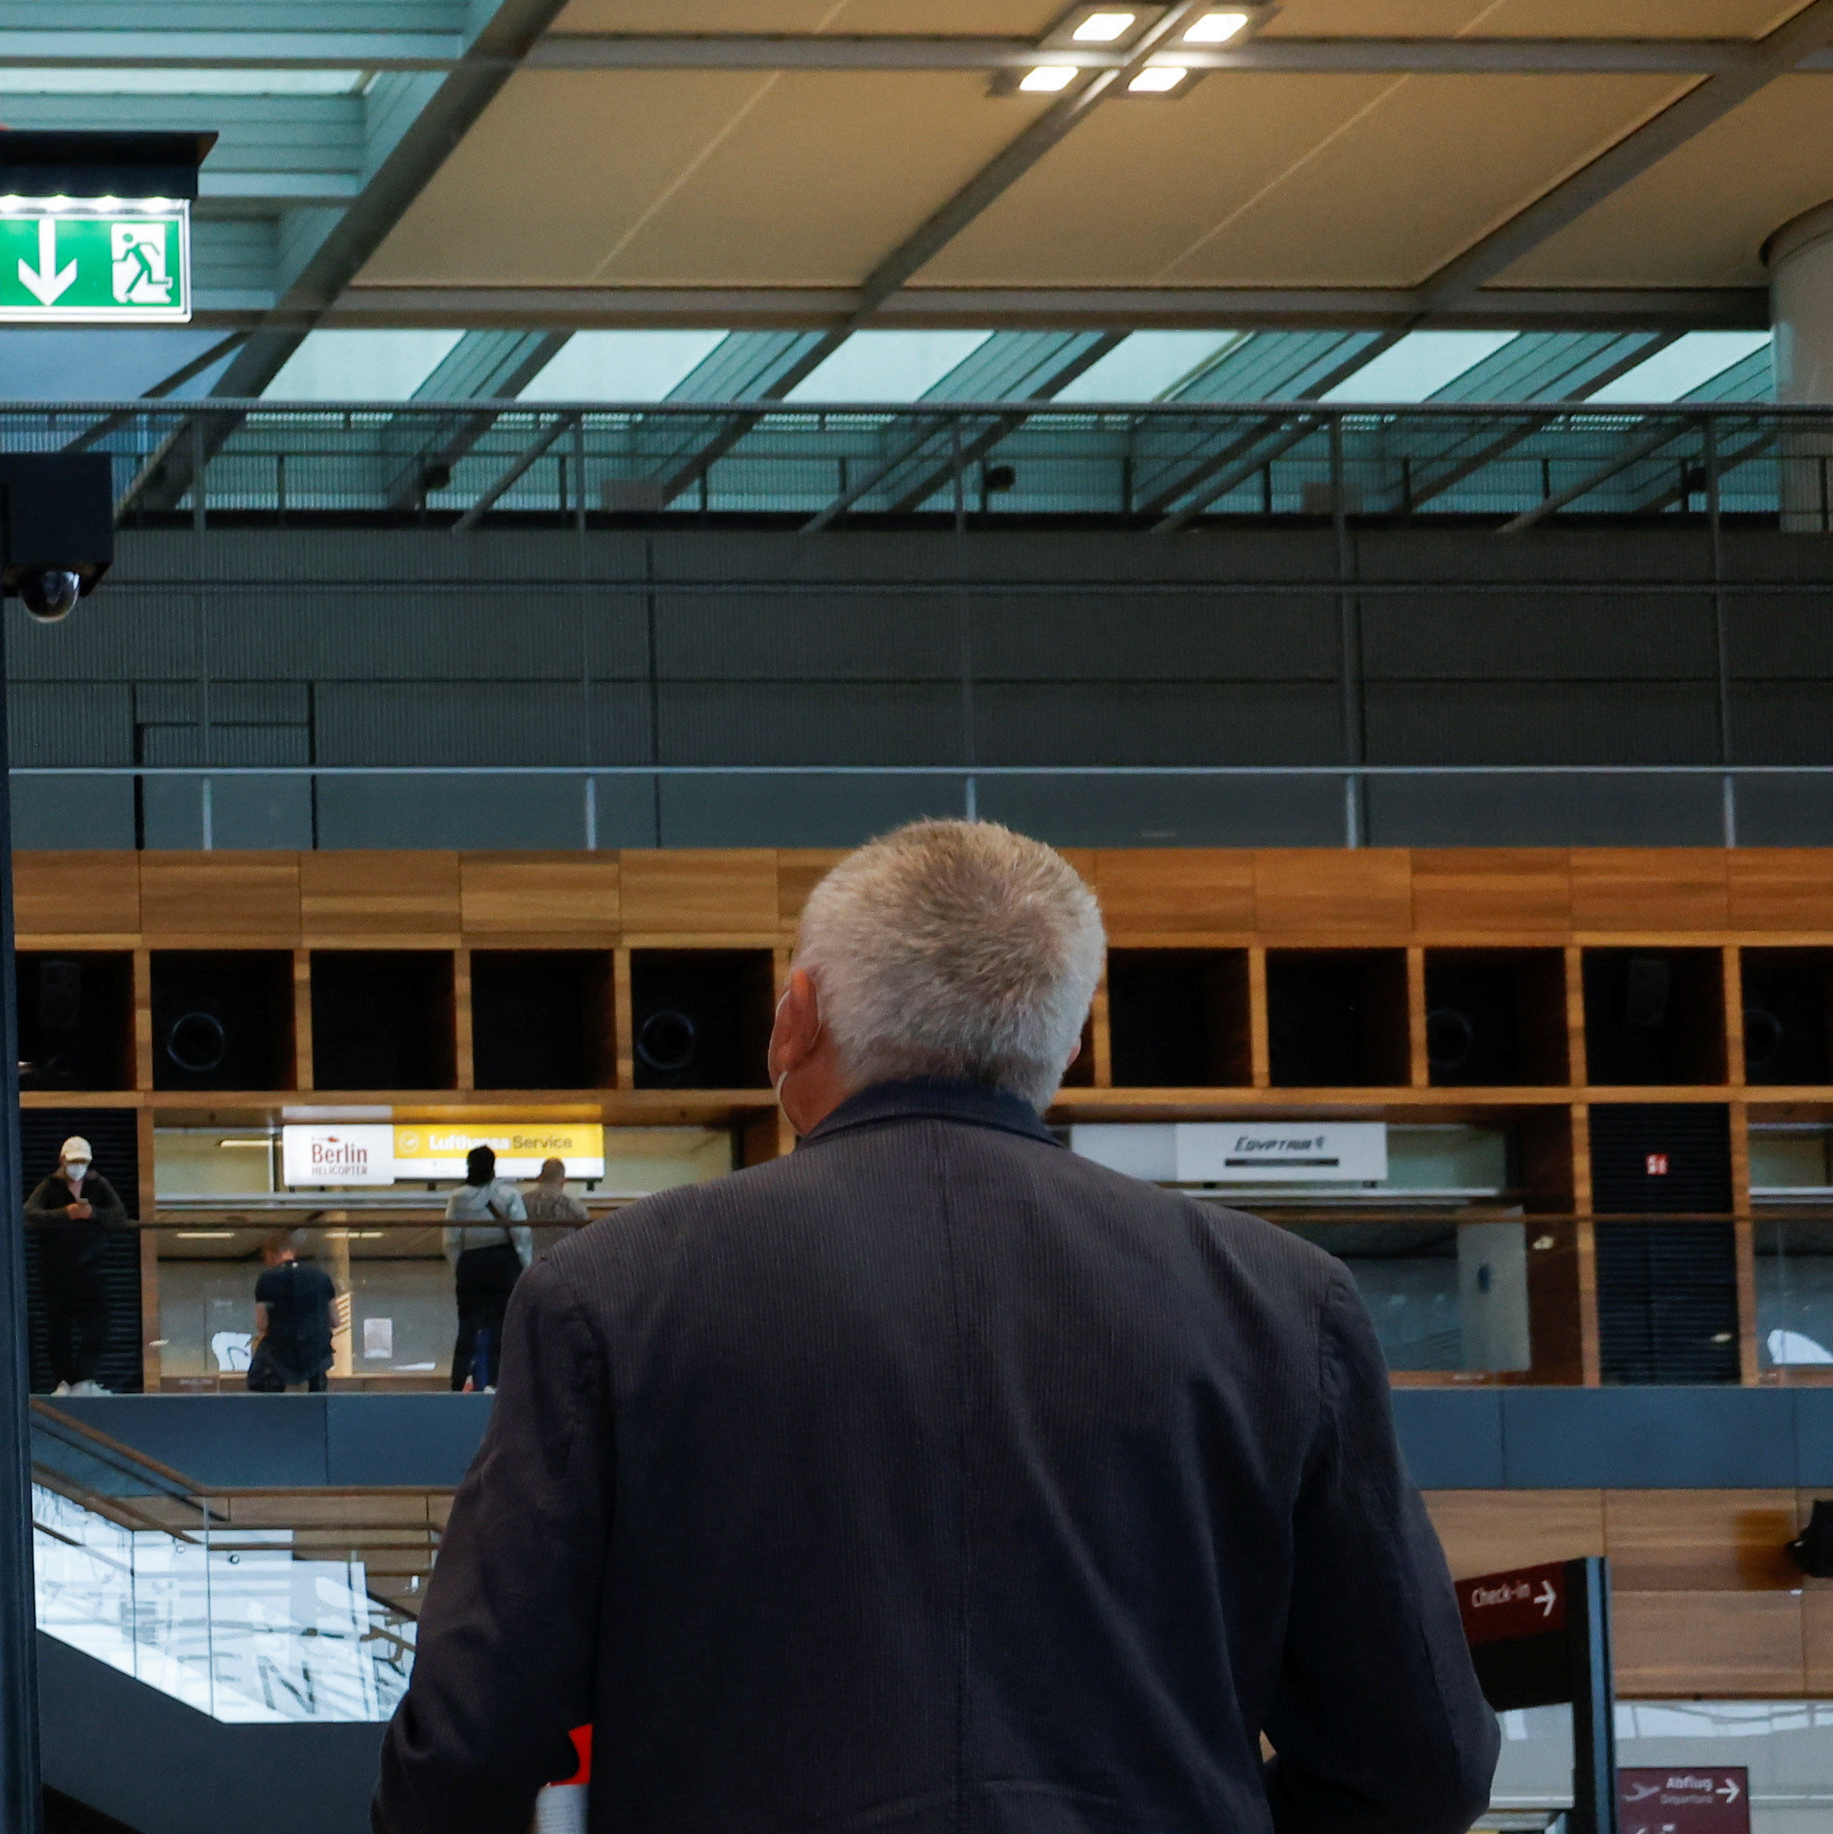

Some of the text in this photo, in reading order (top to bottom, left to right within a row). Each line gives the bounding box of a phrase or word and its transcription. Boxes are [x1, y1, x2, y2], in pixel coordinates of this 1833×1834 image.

[513, 1136, 573, 1149] Service
[311, 1144, 368, 1164] Berlin
[1666, 1775, 1714, 1792] Abflug
